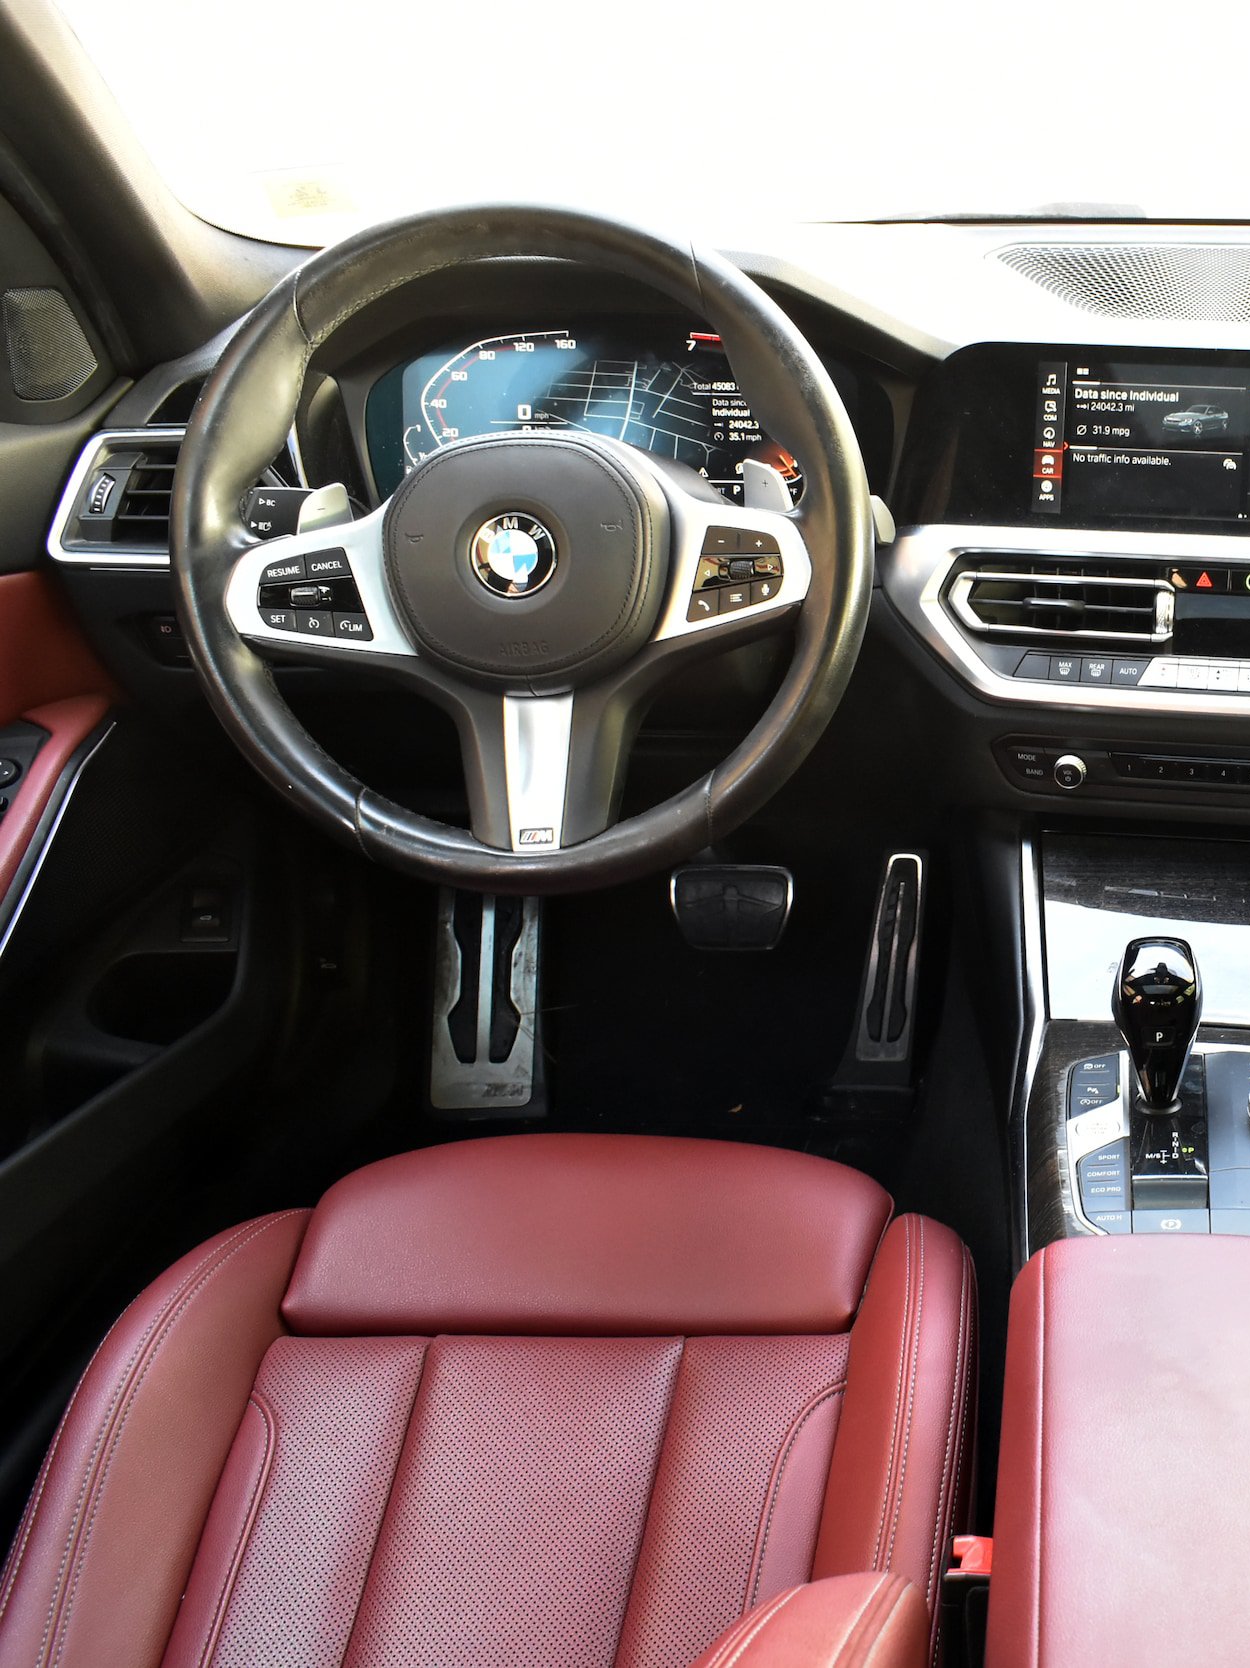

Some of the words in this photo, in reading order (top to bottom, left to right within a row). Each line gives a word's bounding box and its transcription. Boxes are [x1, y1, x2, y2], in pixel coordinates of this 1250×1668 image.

[513, 342, 535, 352] 120
[554, 339, 577, 350] 160
[686, 340, 696, 351] 7
[478, 350, 496, 360] 80
[451, 371, 468, 381] 60
[693, 382, 711, 391] Total
[712, 382, 736, 391] 45083
[1042, 387, 1061, 395] MEDIA
[1074, 388, 1099, 400] Data
[1100, 390, 1127, 401] since
[1130, 390, 1179, 402] Individual
[430, 399, 447, 408] 40
[712, 399, 729, 407] Data
[730, 399, 747, 407] sinc
[1090, 402, 1124, 412] 24042.3
[1125, 404, 1135, 412] mi
[517, 404, 532, 420] 0
[534, 412, 549, 420] mph
[712, 408, 751, 417] Individual
[1043, 414, 1057, 422] COM
[729, 420, 759, 429] 24042.3
[442, 428, 459, 438] 20
[1092, 426, 1111, 436] 31.9
[1112, 428, 1130, 437] mpg
[729, 432, 745, 441] 35.1
[746, 433, 762, 442] mph
[1073, 453, 1085, 463] No
[1087, 454, 1112, 464] traffic
[1113, 454, 1130, 464] info
[1132, 455, 1172, 466] available.
[1041, 467, 1054, 475] CAR
[733, 485, 741, 495] P
[480, 516, 546, 544] BMW
[311, 560, 343, 572] CANCEL
[267, 565, 301, 578] RESUME
[270, 614, 286, 624] SET
[348, 624, 363, 632] LIM
[1058, 661, 1073, 669] MAX
[1088, 663, 1105, 671] REAR
[1119, 667, 1138, 676] AUTO
[1017, 753, 1036, 762] MODE
[1025, 768, 1044, 776] BAND
[1127, 764, 1132, 772] 1
[1158, 766, 1164, 774] 2
[1189, 768, 1194, 776] 3
[1220, 769, 1226, 777] 4
[1156, 1032, 1163, 1042] P
